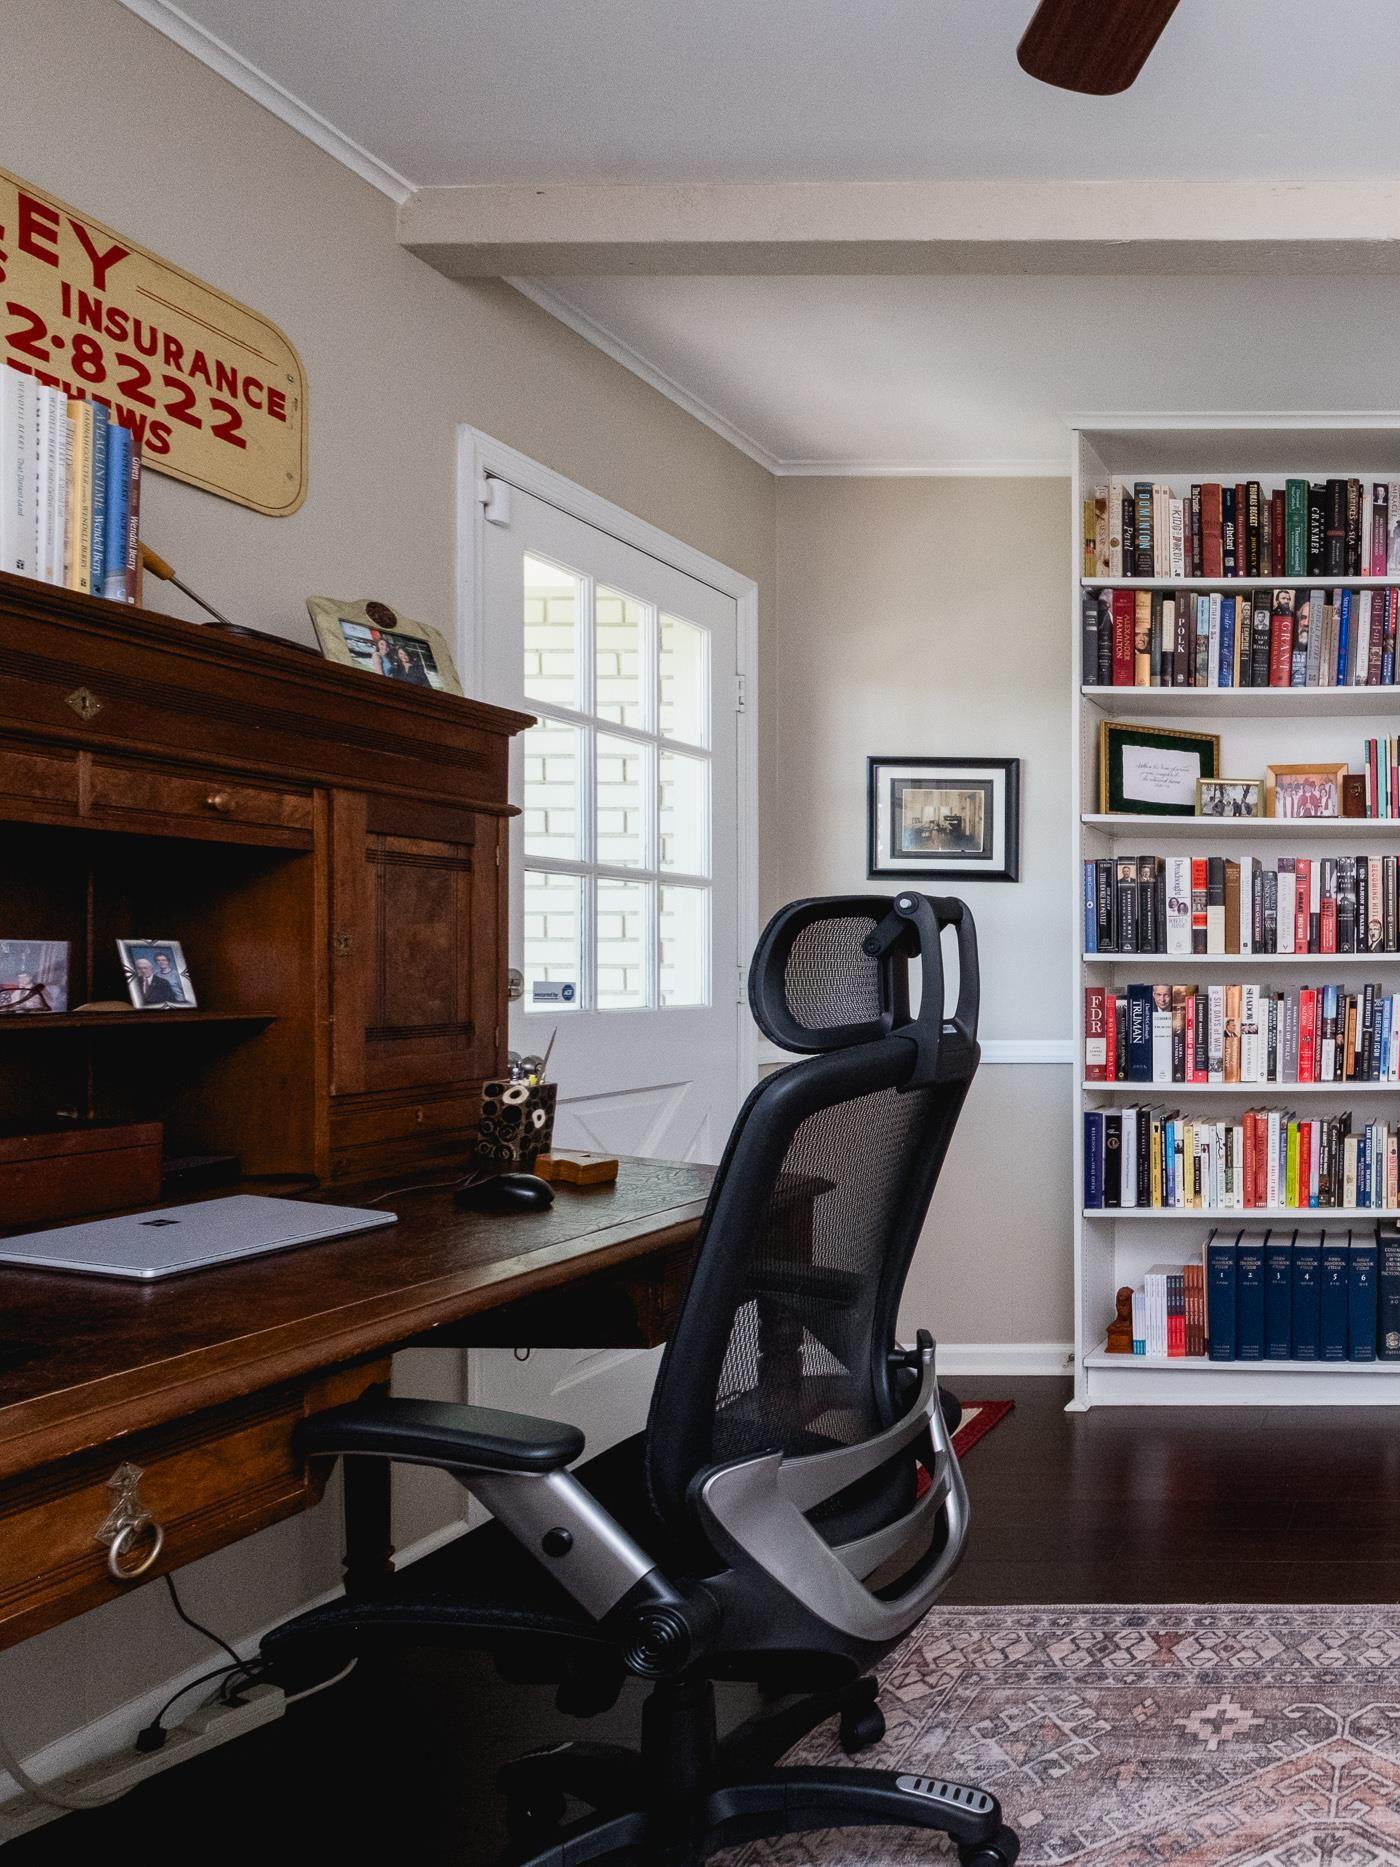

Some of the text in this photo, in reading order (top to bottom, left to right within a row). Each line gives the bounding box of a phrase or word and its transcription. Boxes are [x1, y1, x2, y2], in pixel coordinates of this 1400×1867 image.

[0, 192, 132, 292] EY
[61, 280, 287, 424] INSURANCE
[82, 408, 90, 446] HANNAH
[94, 411, 106, 422] A
[94, 421, 106, 461] PLACE
[94, 476, 106, 509] TIME
[1249, 484, 1258, 527] THOMAS BECKET
[93, 514, 104, 551] Wendell
[127, 456, 141, 571] Given Wendell Berry
[1138, 493, 1150, 549] DOMINION
[1311, 507, 1320, 554] CRANMER
[1124, 525, 1134, 551] Paul
[91, 551, 103, 577] Berry
[1177, 617, 1186, 653] POLK
[1279, 621, 1292, 672] GRANT
[1173, 859, 1184, 896] Dreadnought
[1371, 863, 1379, 901] BECOMING
[1099, 872, 1107, 926] THEODORE ROOSEVELT
[1321, 901, 1334, 918] 1917
[1359, 905, 1365, 914] DE
[1090, 995, 1103, 1034] FDR
[1132, 999, 1143, 1044] TRUMAN
[1245, 987, 1254, 1023] SHADOW
[1213, 996, 1221, 1053] SIX DAYS WAR
[1285, 1032, 1291, 1040] OF
[1373, 1042, 1381, 1057] ICON
[1257, 1135, 1265, 1169] HEAVEN
